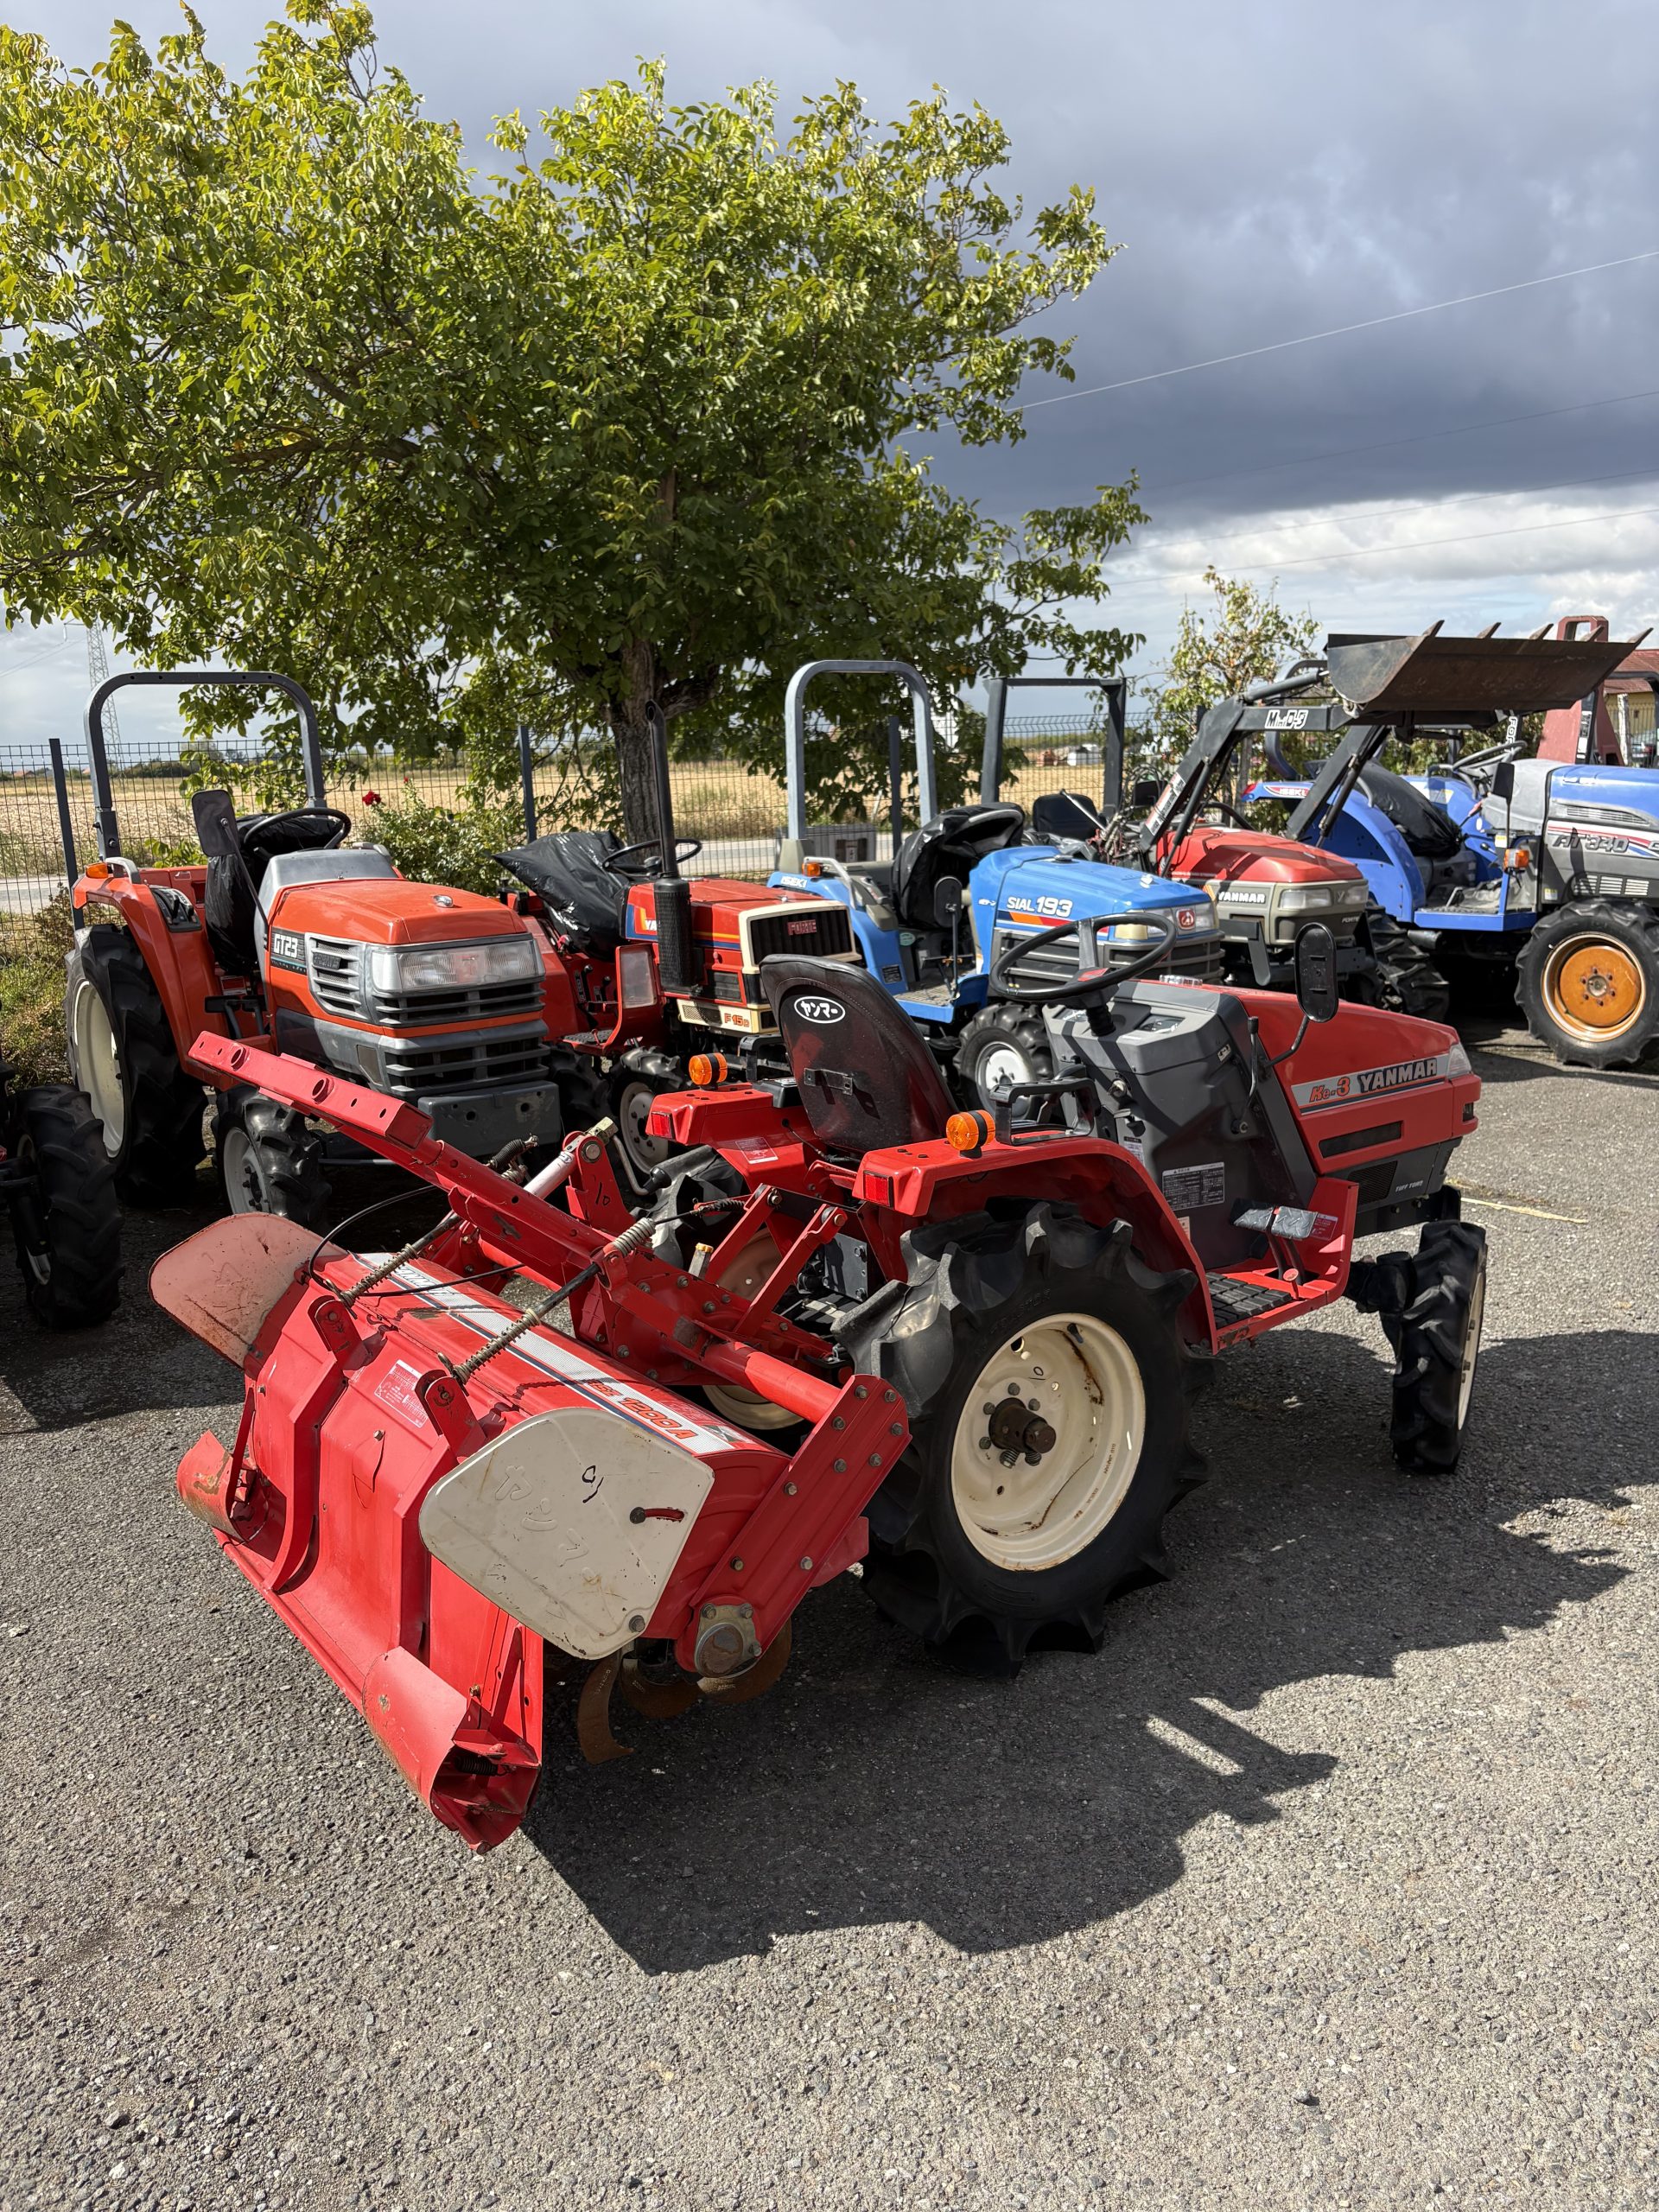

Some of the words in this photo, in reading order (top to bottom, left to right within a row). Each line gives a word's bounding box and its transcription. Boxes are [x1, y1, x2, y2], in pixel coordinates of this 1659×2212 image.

[780, 876, 808, 888] ISEKI
[1218, 890, 1266, 904] YANMAR
[1007, 896, 1035, 912] SIAL
[1035, 895, 1073, 918] 193
[787, 919, 817, 936] FORTE
[1342, 916, 1360, 925] FORT
[273, 933, 298, 958] GT23
[800, 1000, 839, 1018] ヤンマー
[1309, 1077, 1351, 1103] Ke-3
[1357, 1057, 1438, 1094] YANMAR
[582, 1465, 605, 1503] 9
